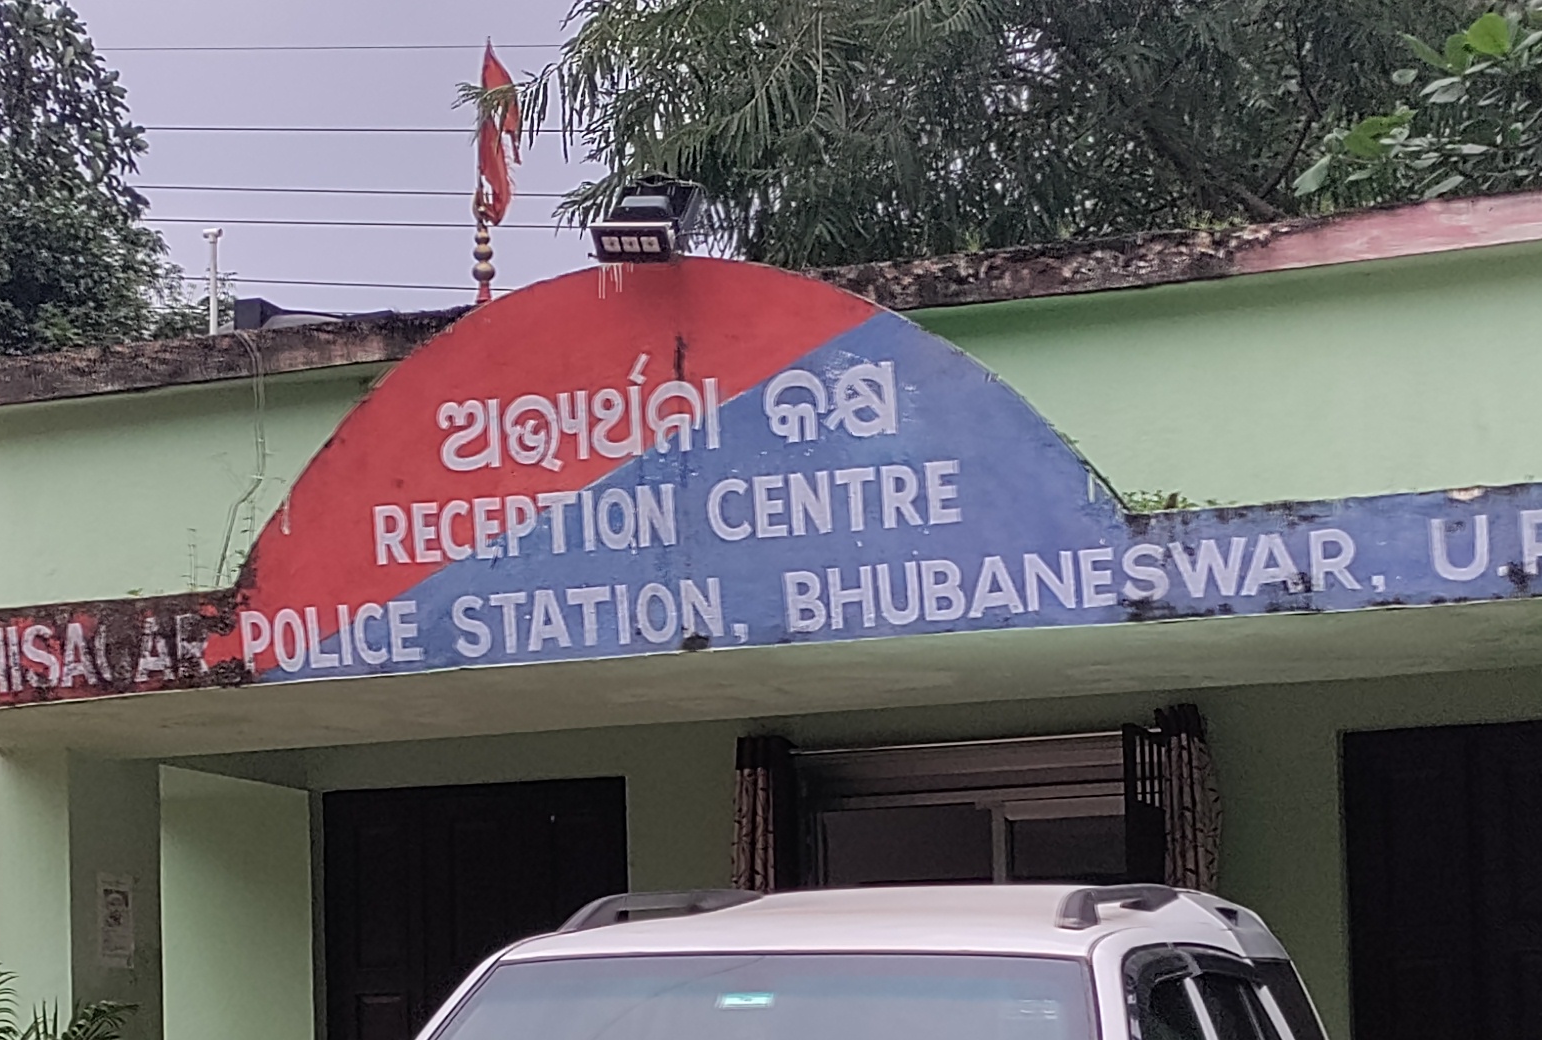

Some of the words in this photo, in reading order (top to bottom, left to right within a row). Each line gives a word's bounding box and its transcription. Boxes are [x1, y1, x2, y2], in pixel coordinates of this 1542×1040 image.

[436, 353, 721, 472] ଅଭ୍ୟର୍ଥନା
[764, 360, 898, 444] କକ୍ଷ
[374, 483, 676, 566] RECEPTION
[706, 460, 962, 542] CENTRE
[240, 600, 424, 675] POLICE
[452, 577, 749, 658] STATION,
[783, 528, 1387, 633] BHUBANESWAR,
